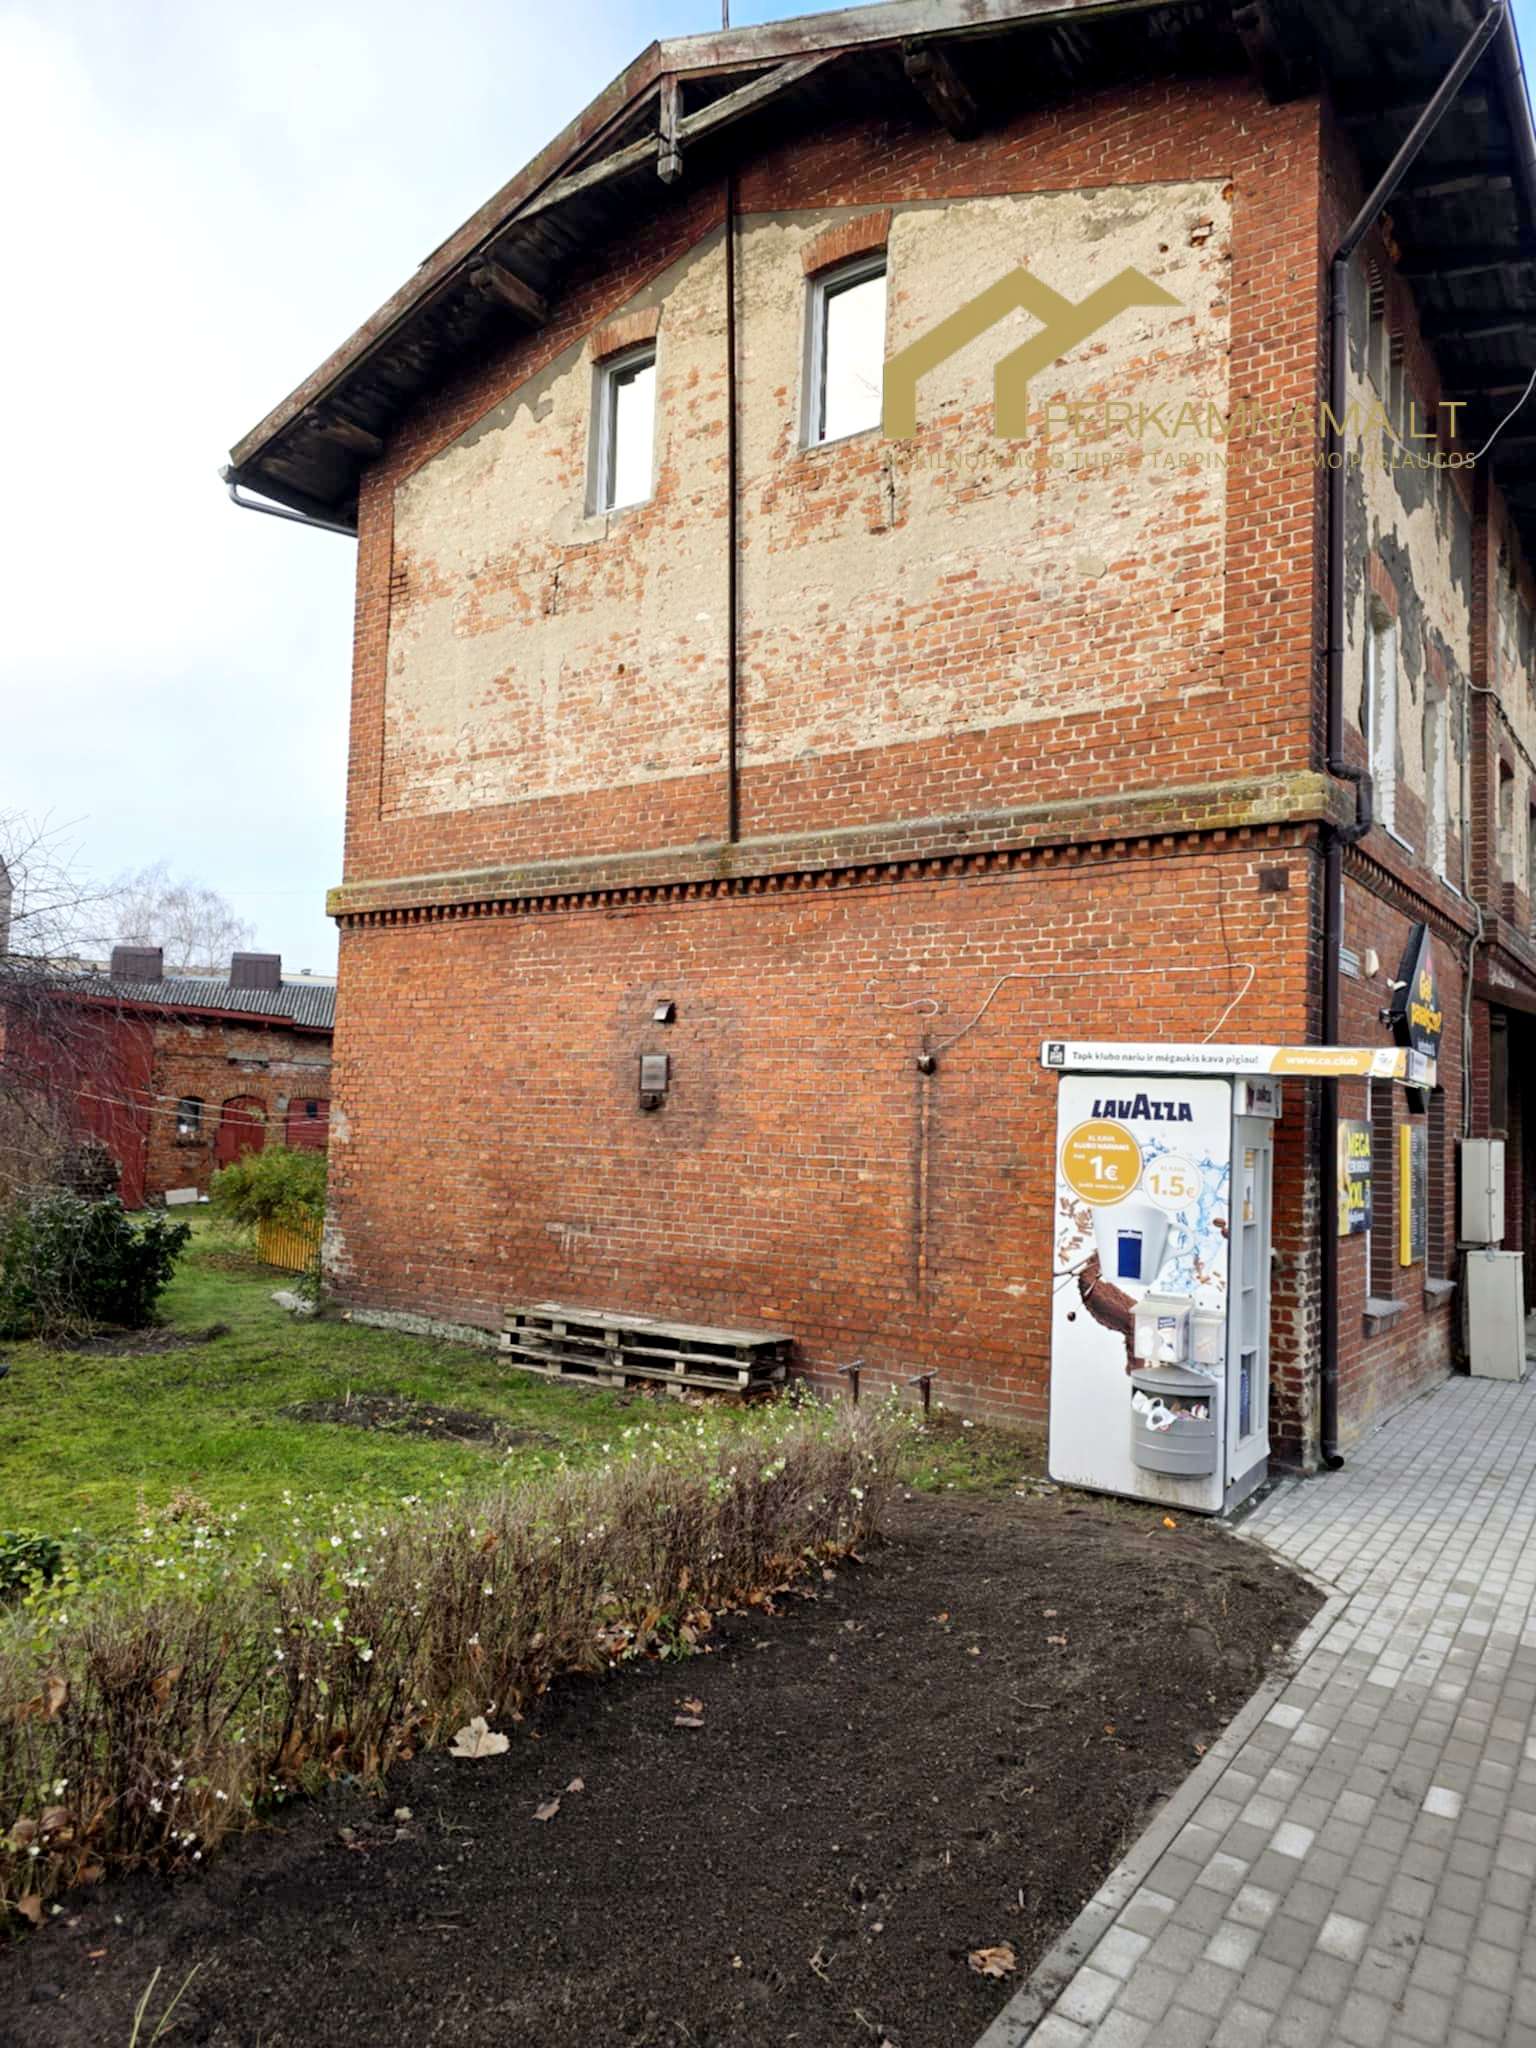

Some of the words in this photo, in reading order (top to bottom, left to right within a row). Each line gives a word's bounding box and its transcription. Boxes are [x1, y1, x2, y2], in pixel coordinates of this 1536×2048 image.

[1095, 1051, 1120, 1061] klubo
[1091, 1093, 1193, 1122] LAVAZZA
[1089, 1155, 1119, 1181] 1€
